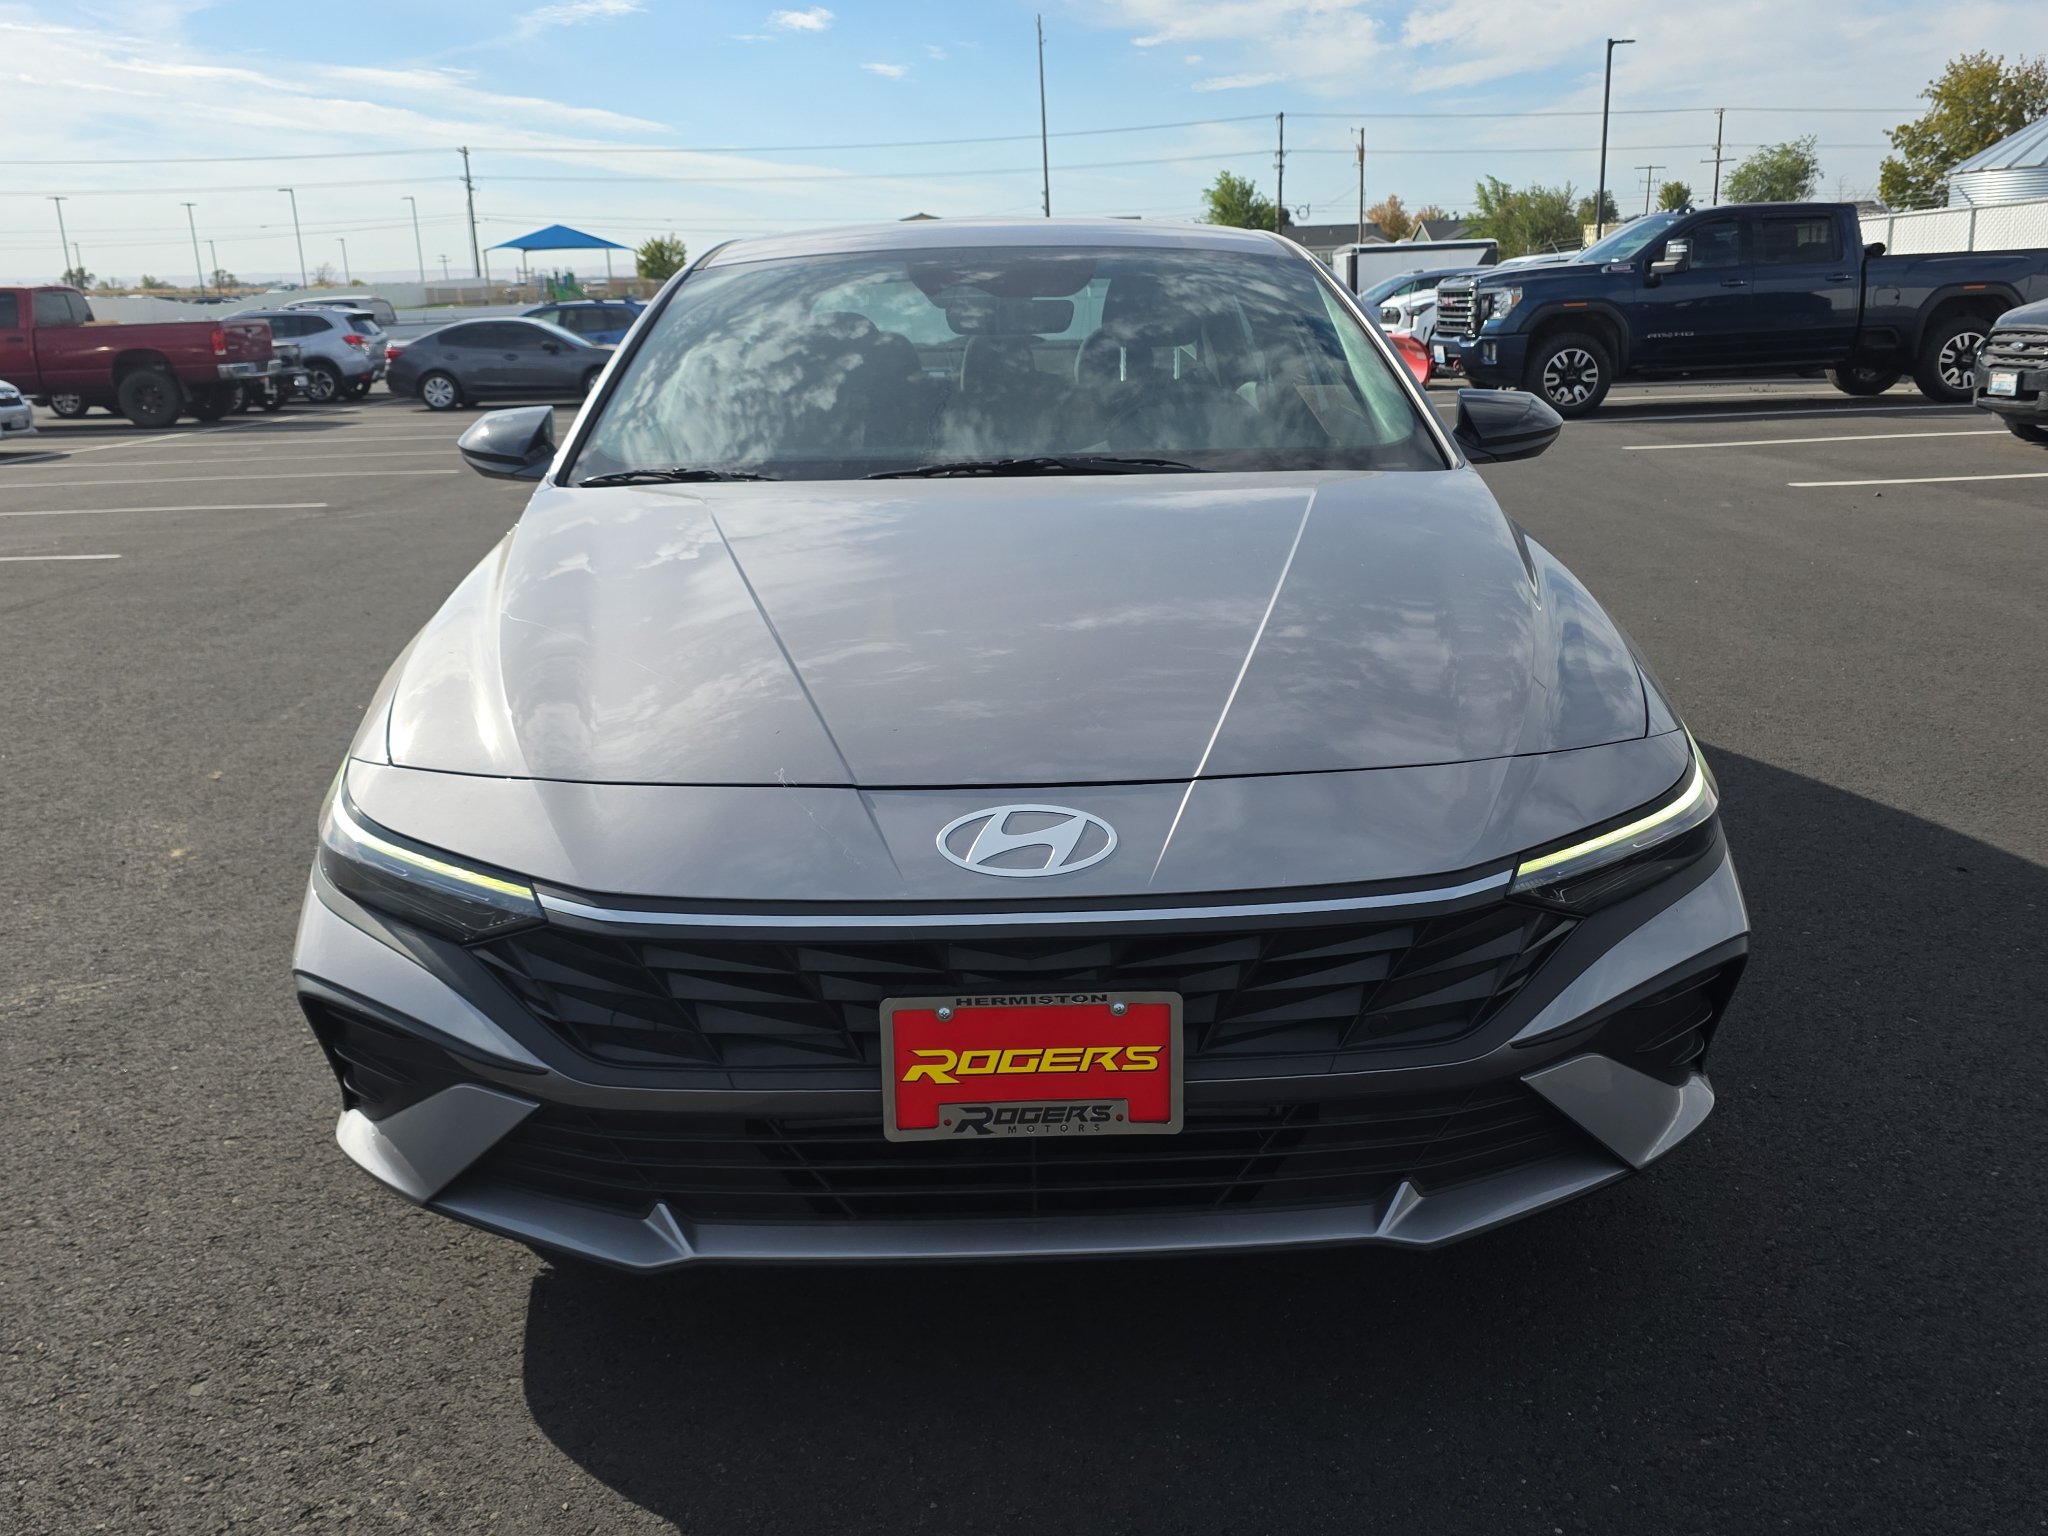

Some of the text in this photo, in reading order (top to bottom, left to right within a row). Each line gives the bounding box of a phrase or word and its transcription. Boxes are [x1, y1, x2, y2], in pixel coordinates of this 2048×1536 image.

[955, 994, 1108, 1006] HERMISTON
[901, 1045, 1164, 1085] ROGERS
[952, 1105, 1114, 1135] ROGERS
[1007, 1123, 1101, 1135] MOTORS
